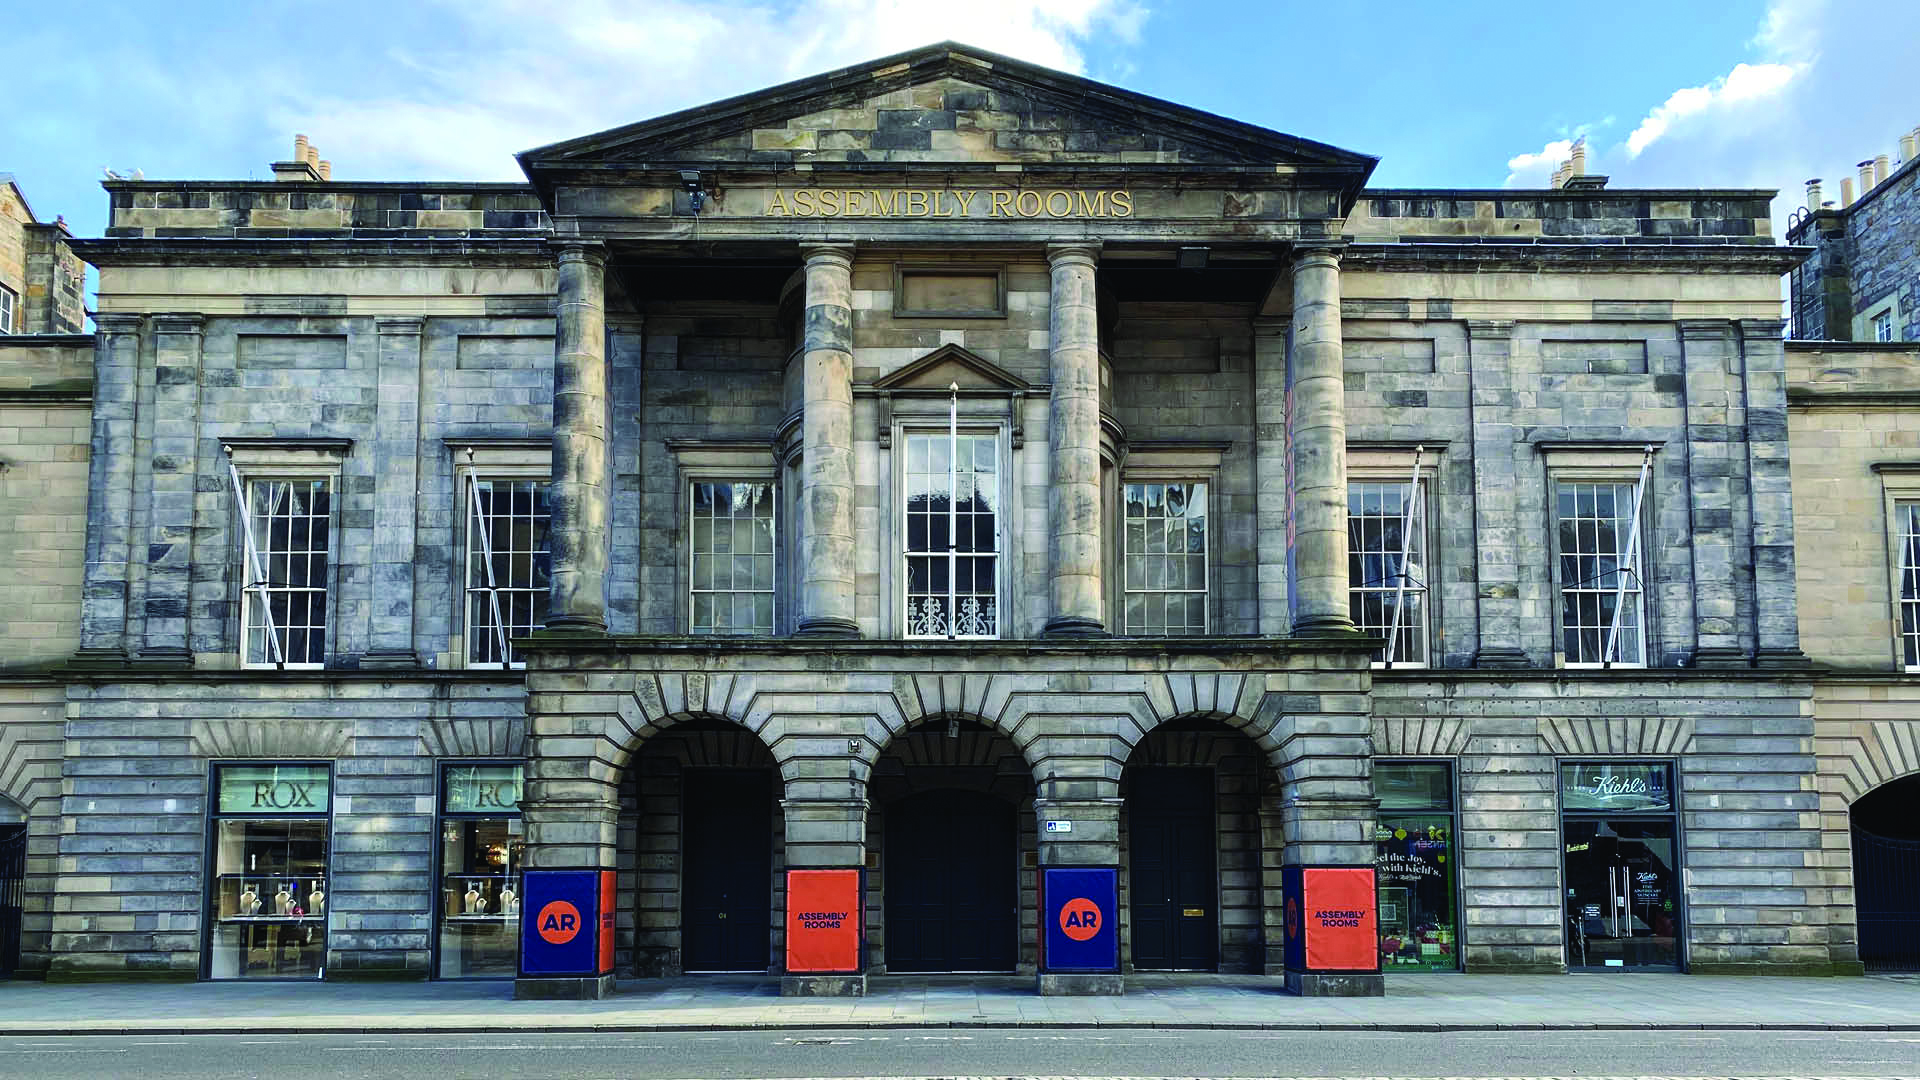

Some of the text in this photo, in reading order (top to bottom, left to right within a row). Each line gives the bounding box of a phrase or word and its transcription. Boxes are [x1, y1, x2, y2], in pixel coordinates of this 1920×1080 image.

[766, 189, 1132, 217] ASSEMBLY ROOMS
[1588, 775, 1647, 795] Kiehl's
[251, 781, 316, 809] ROX
[476, 781, 522, 809] RO
[1390, 852, 1405, 862] the
[1382, 863, 1404, 872] with
[797, 912, 848, 920] ASSEMBLY
[1065, 911, 1097, 928] AR
[1315, 910, 1365, 919] ASSEMBLY
[542, 913, 576, 931] AR
[804, 921, 841, 929] ROOMS
[1322, 920, 1359, 928] ROOMS
